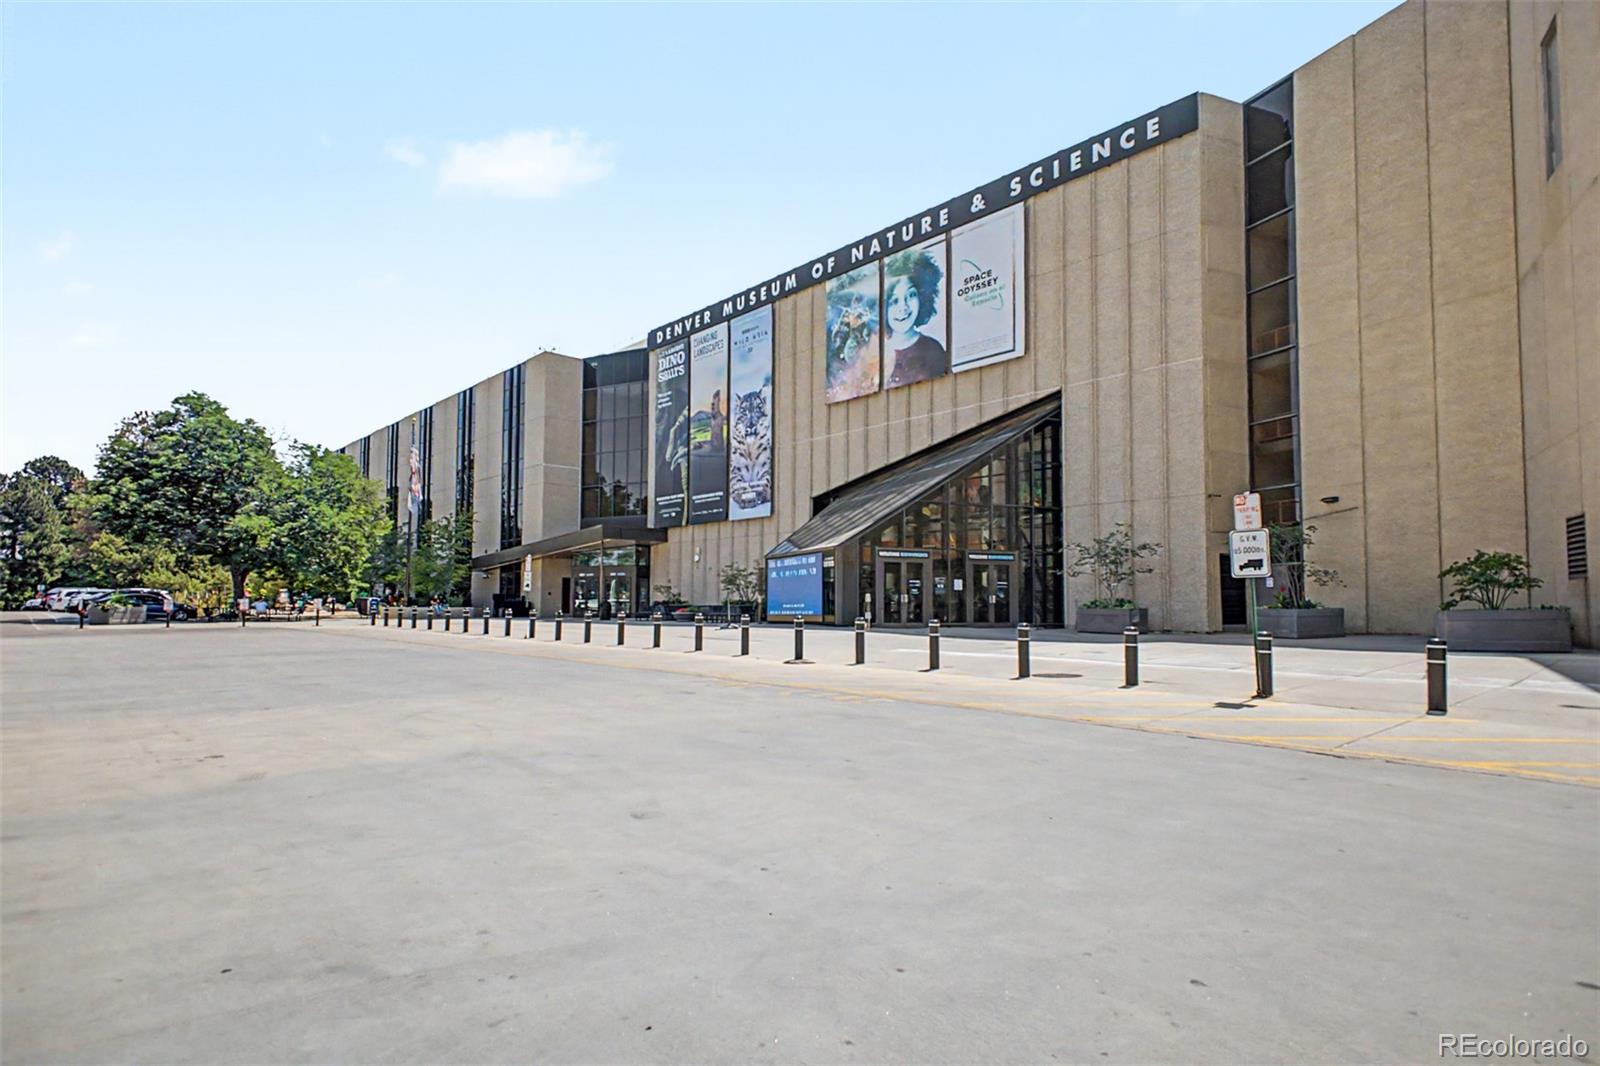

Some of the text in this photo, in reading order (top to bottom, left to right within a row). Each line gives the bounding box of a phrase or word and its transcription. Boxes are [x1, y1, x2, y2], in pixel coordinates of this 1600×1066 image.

[655, 116, 1161, 344] DENVER MUSEUM OF NATURE & SCIENCE
[957, 275, 999, 297] ODYSSEY
[963, 268, 993, 286] SPACE
[693, 339, 724, 358] LANDSCAPES
[658, 351, 685, 371] DINO
